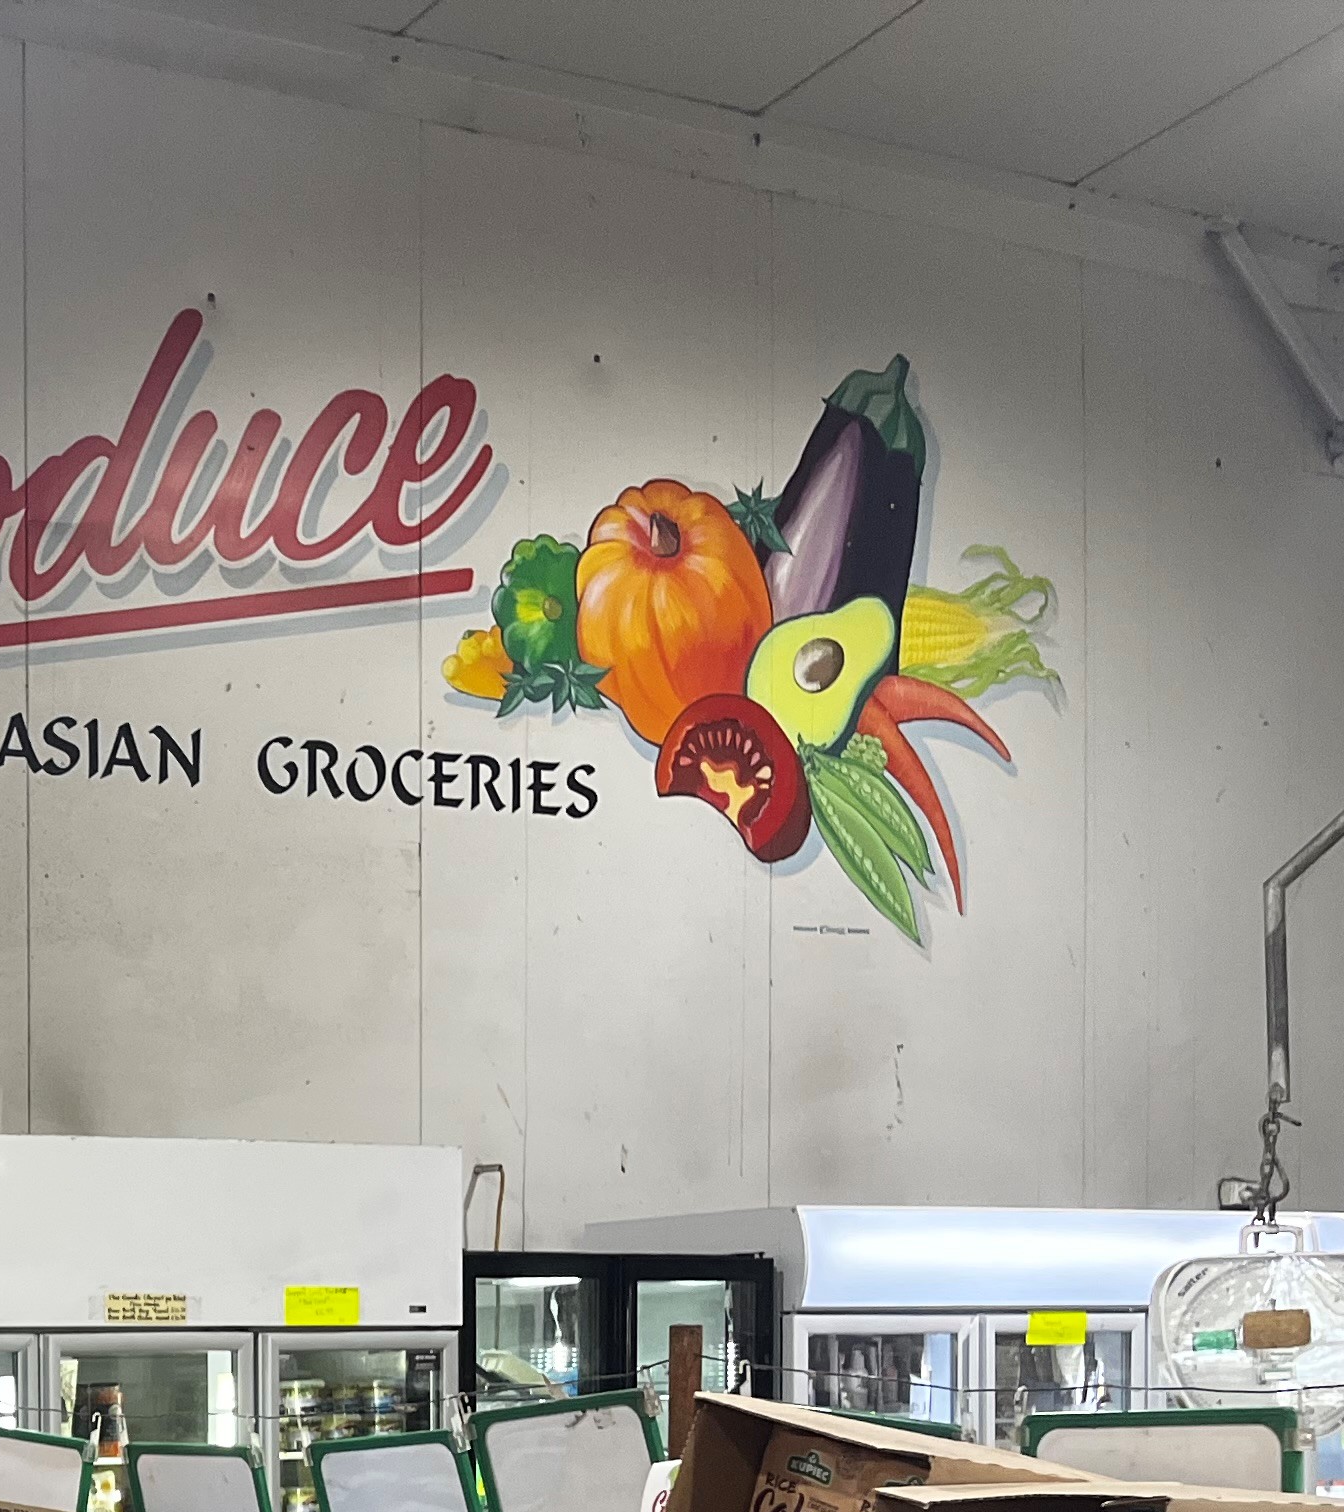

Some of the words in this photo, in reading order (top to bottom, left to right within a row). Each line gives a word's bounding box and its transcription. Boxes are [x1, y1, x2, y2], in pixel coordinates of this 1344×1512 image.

[258, 735, 600, 820] GROCERIES
[765, 1471, 797, 1494] RICE
[789, 1459, 830, 1484] KUPIEC
